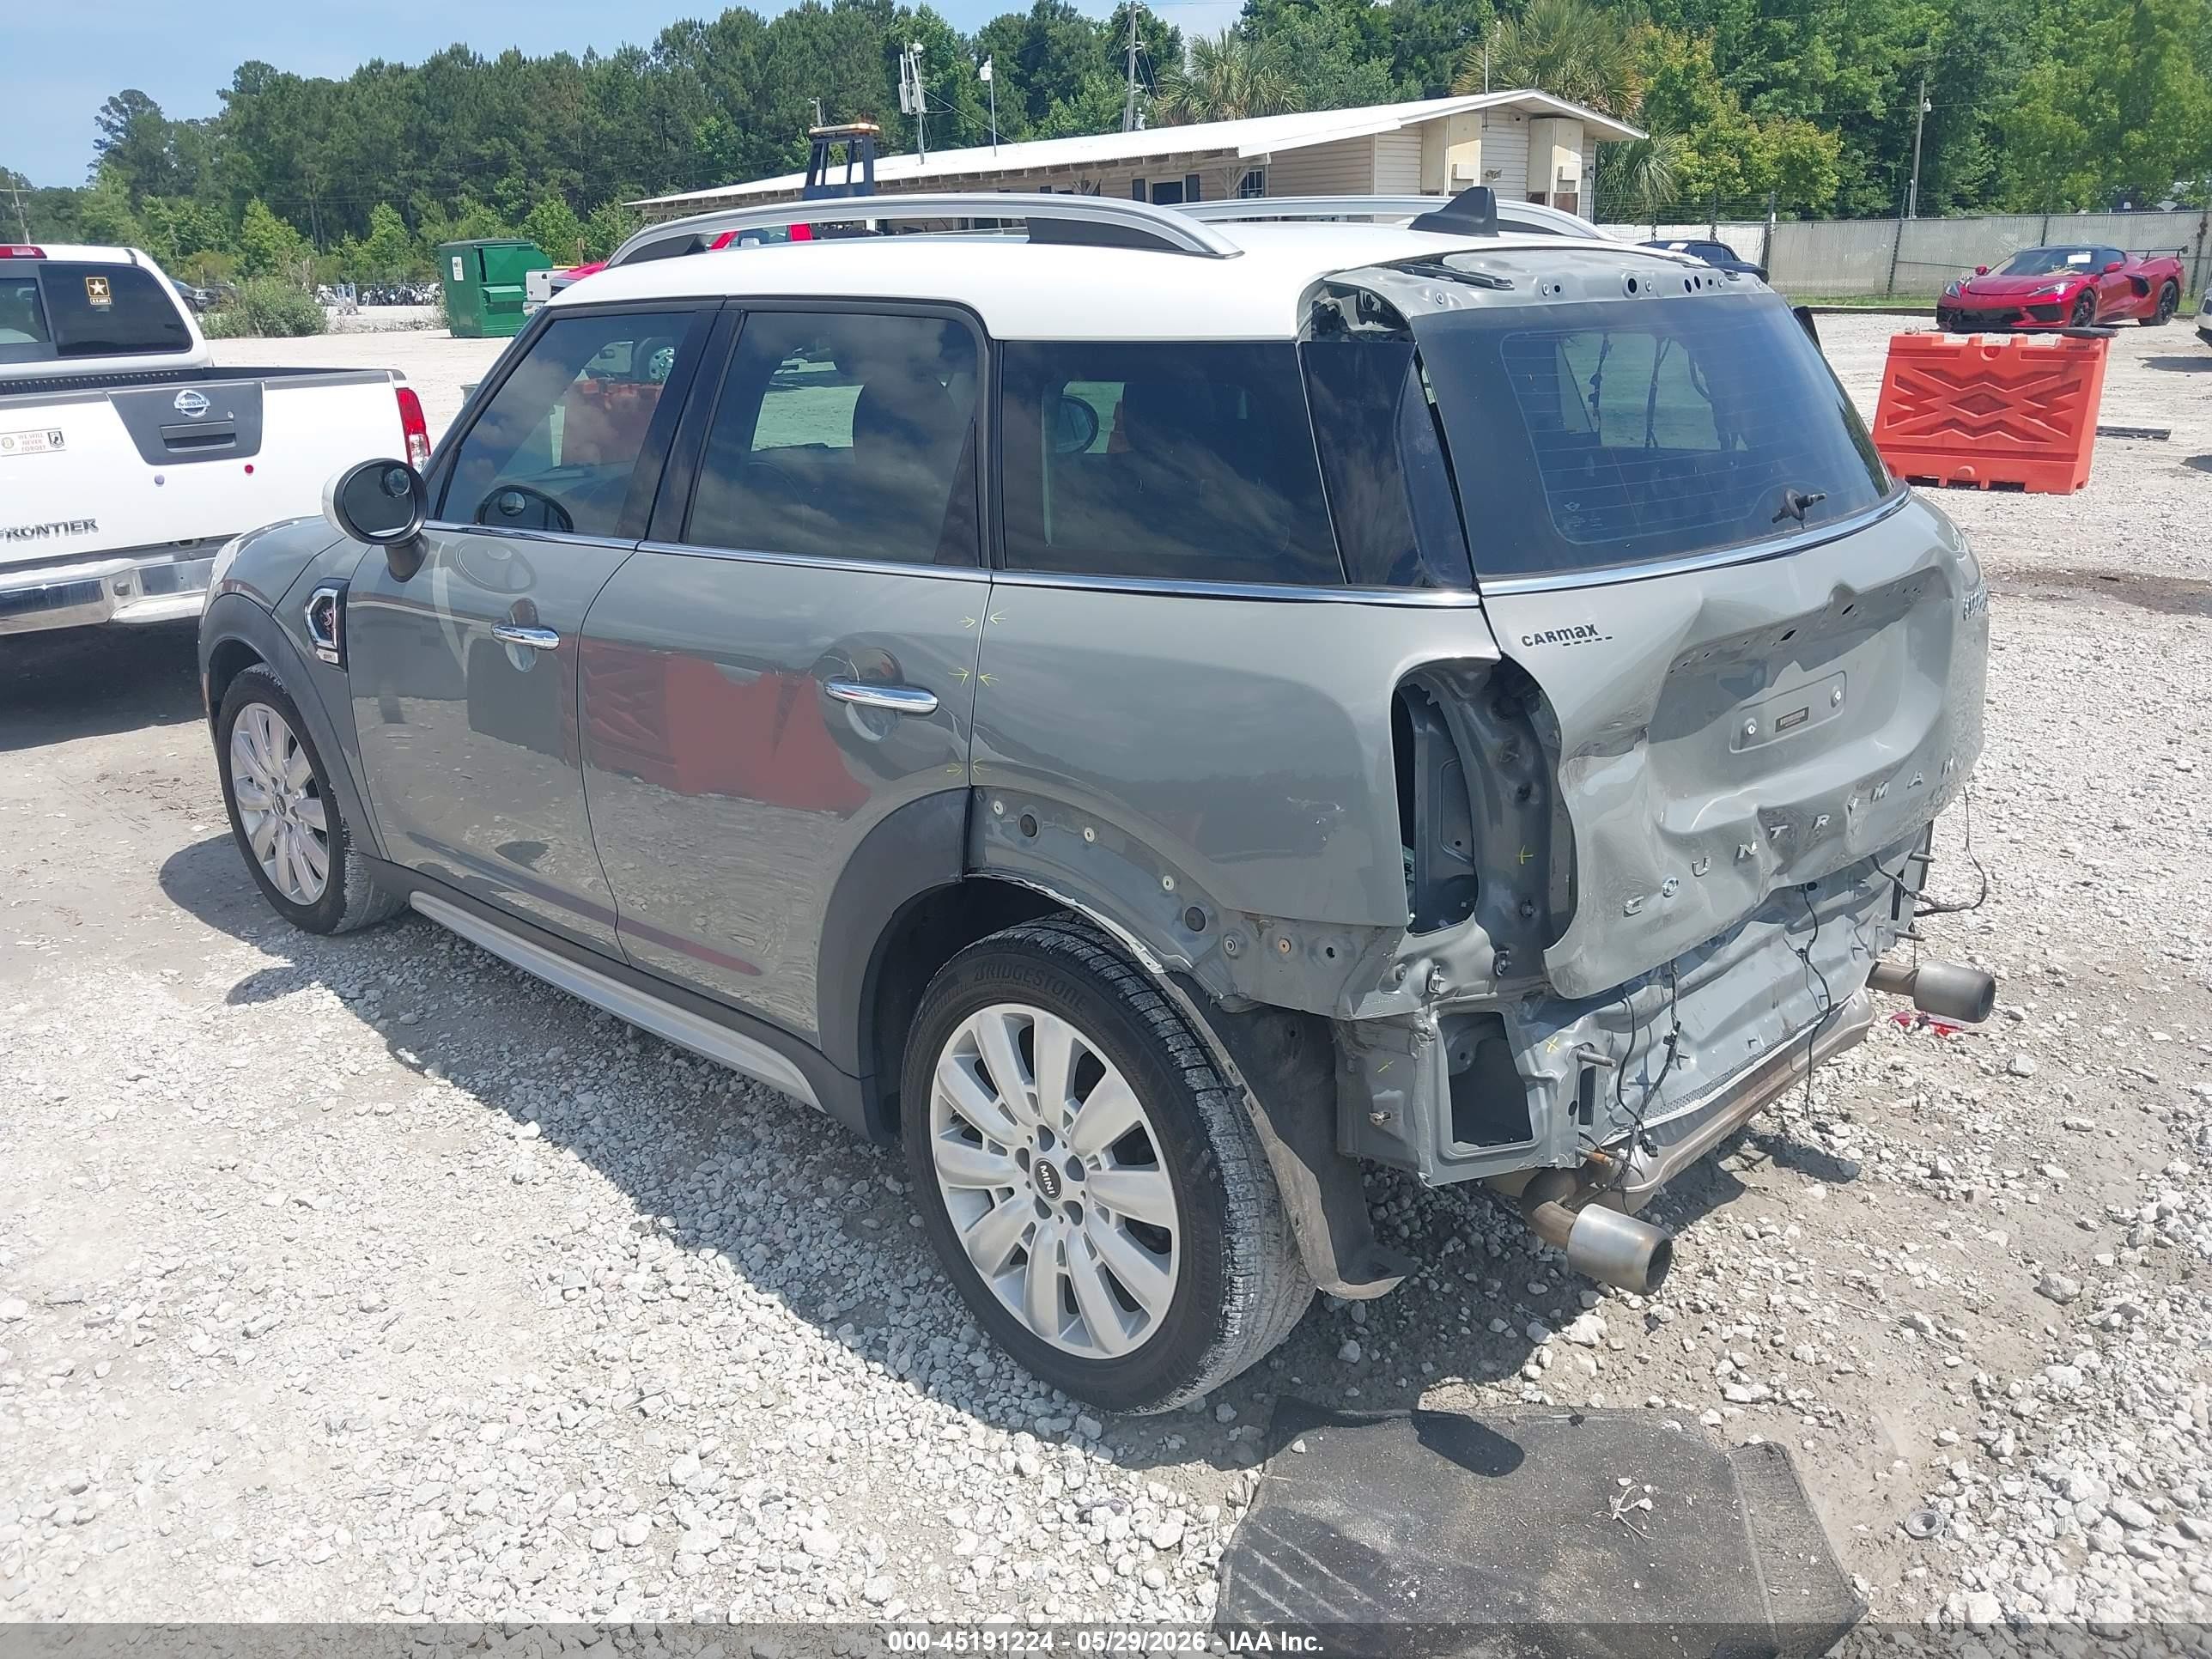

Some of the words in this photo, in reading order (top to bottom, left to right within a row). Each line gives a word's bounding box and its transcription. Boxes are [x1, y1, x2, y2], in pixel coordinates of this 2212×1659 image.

[178, 398, 207, 408] NISSAN
[974, 962, 1086, 1012] BRIDGESTONE
[1040, 1164, 1055, 1194] MINI
